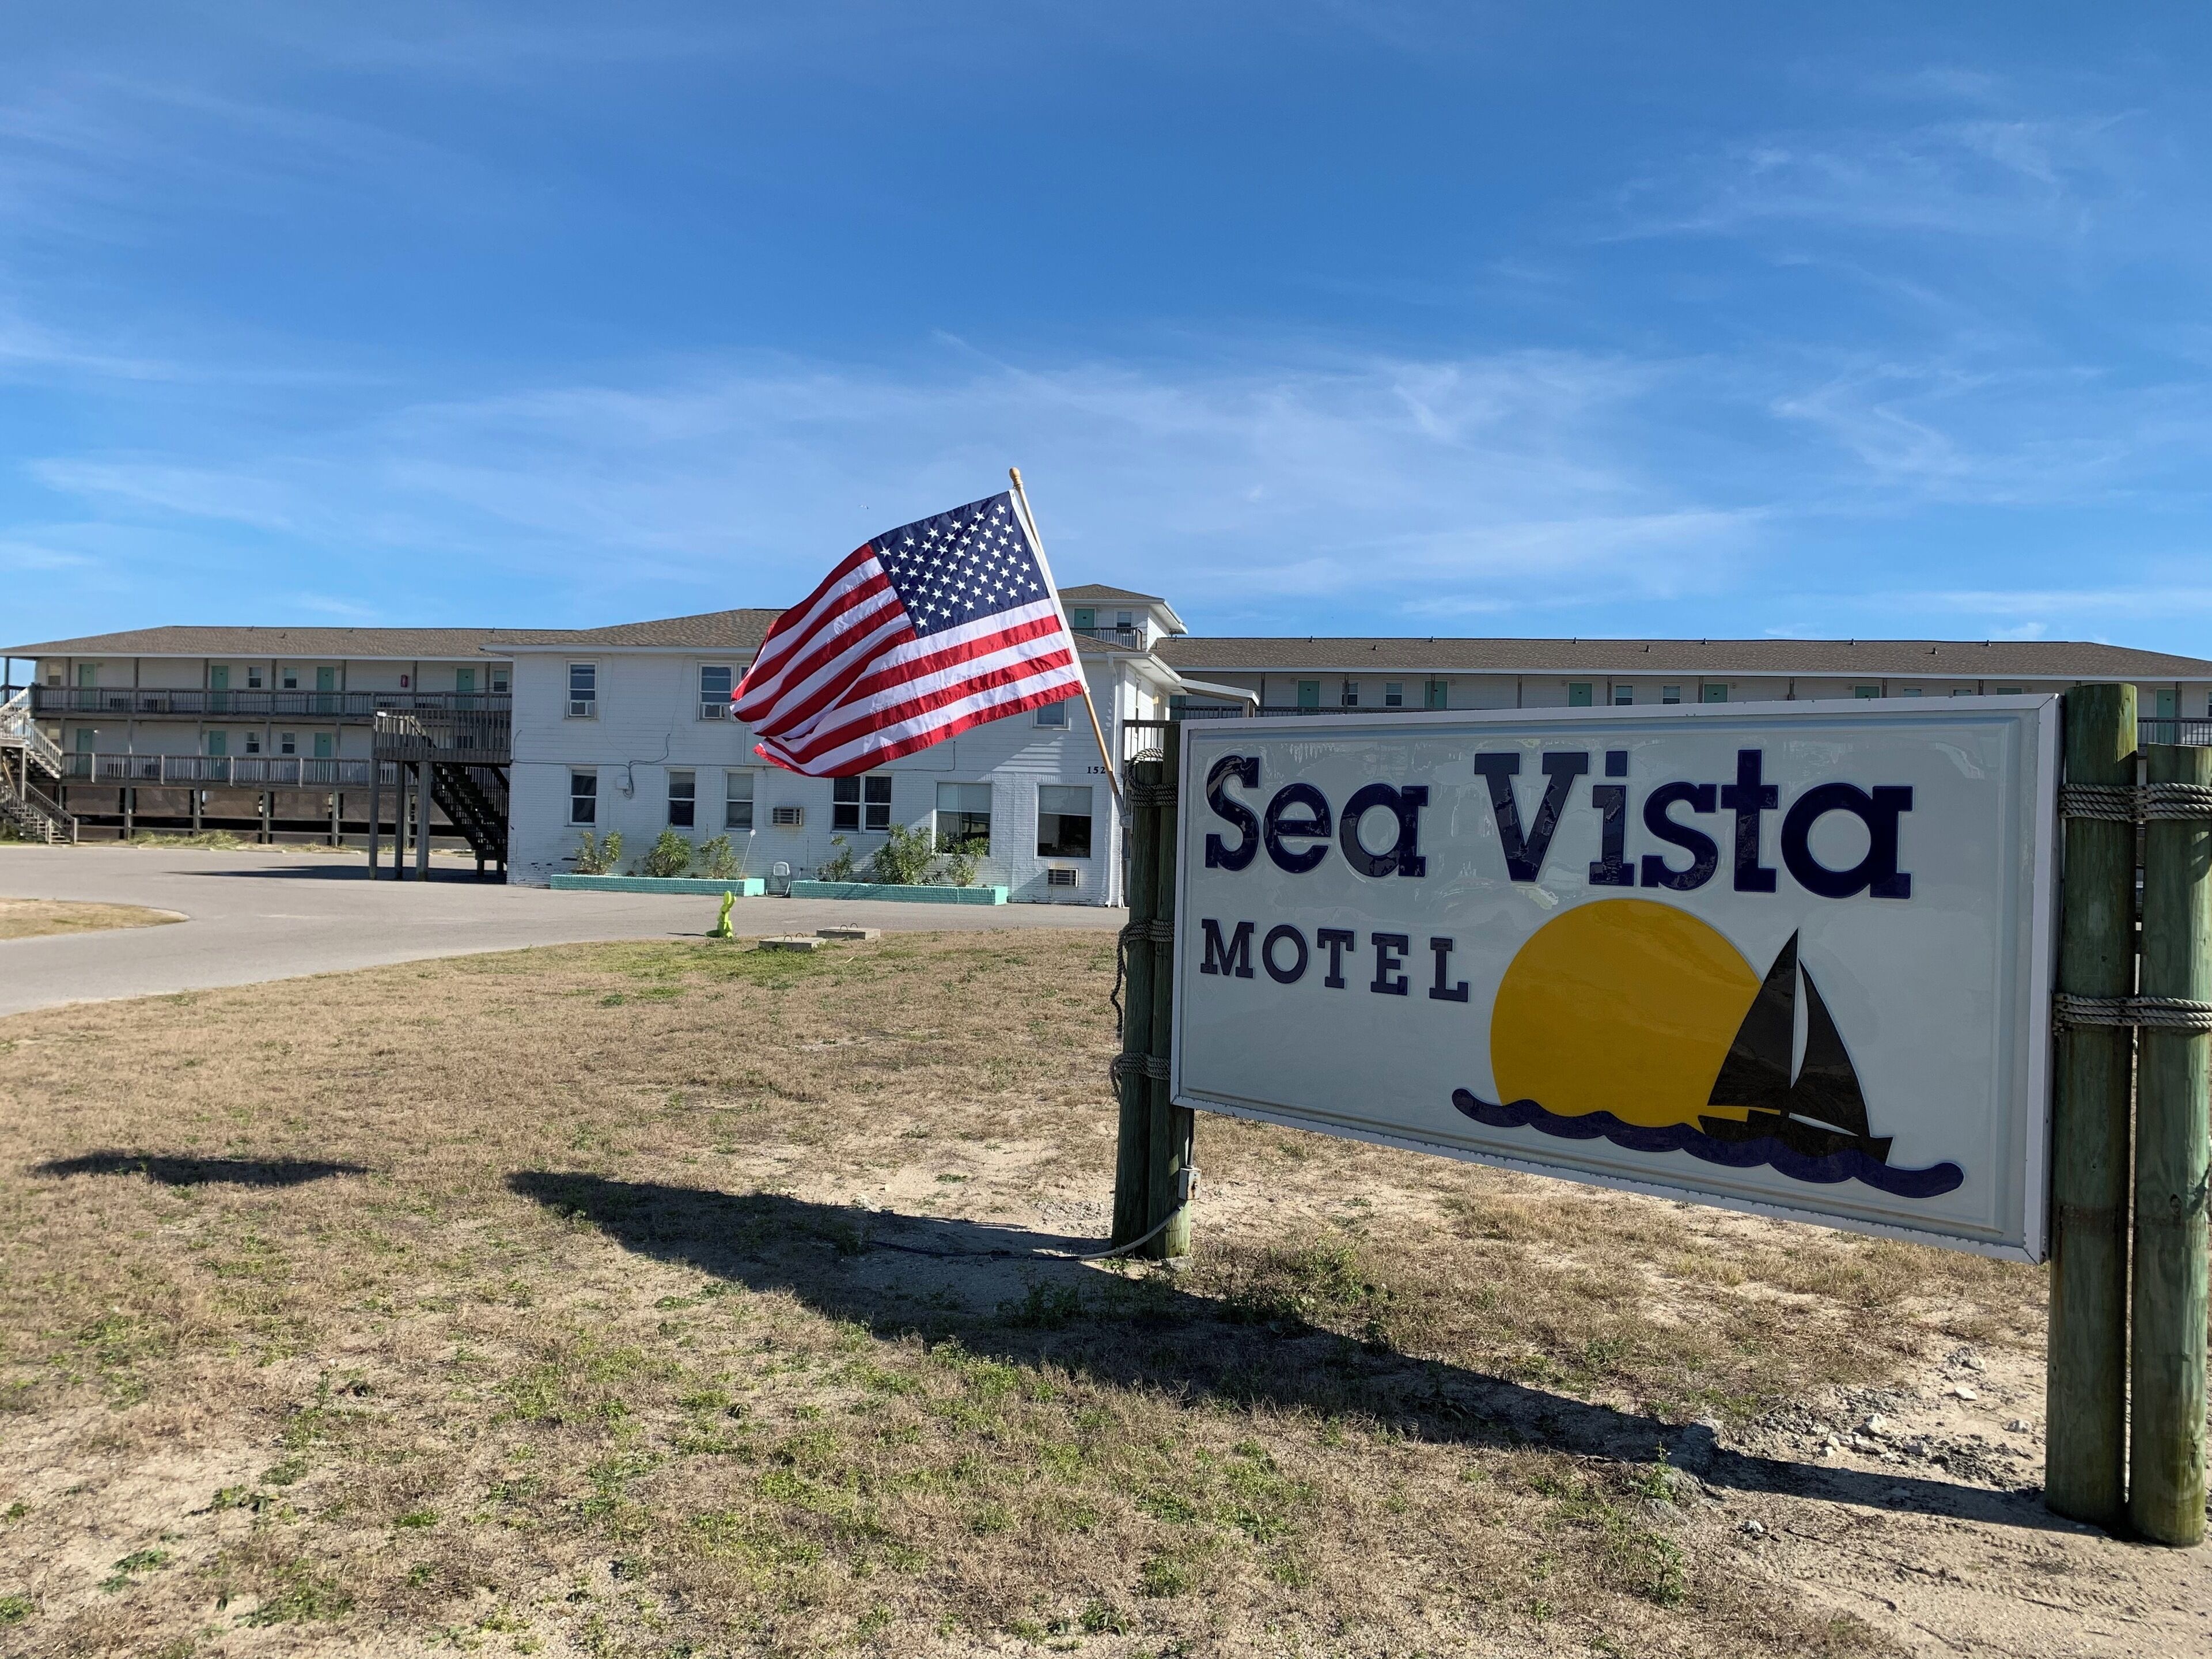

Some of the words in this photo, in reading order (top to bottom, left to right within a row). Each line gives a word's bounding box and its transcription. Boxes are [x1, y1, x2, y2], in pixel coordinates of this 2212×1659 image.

[1205, 755, 1429, 877] Sea
[1474, 749, 1914, 899] Vista
[1200, 919, 1469, 1002] MOTEL
